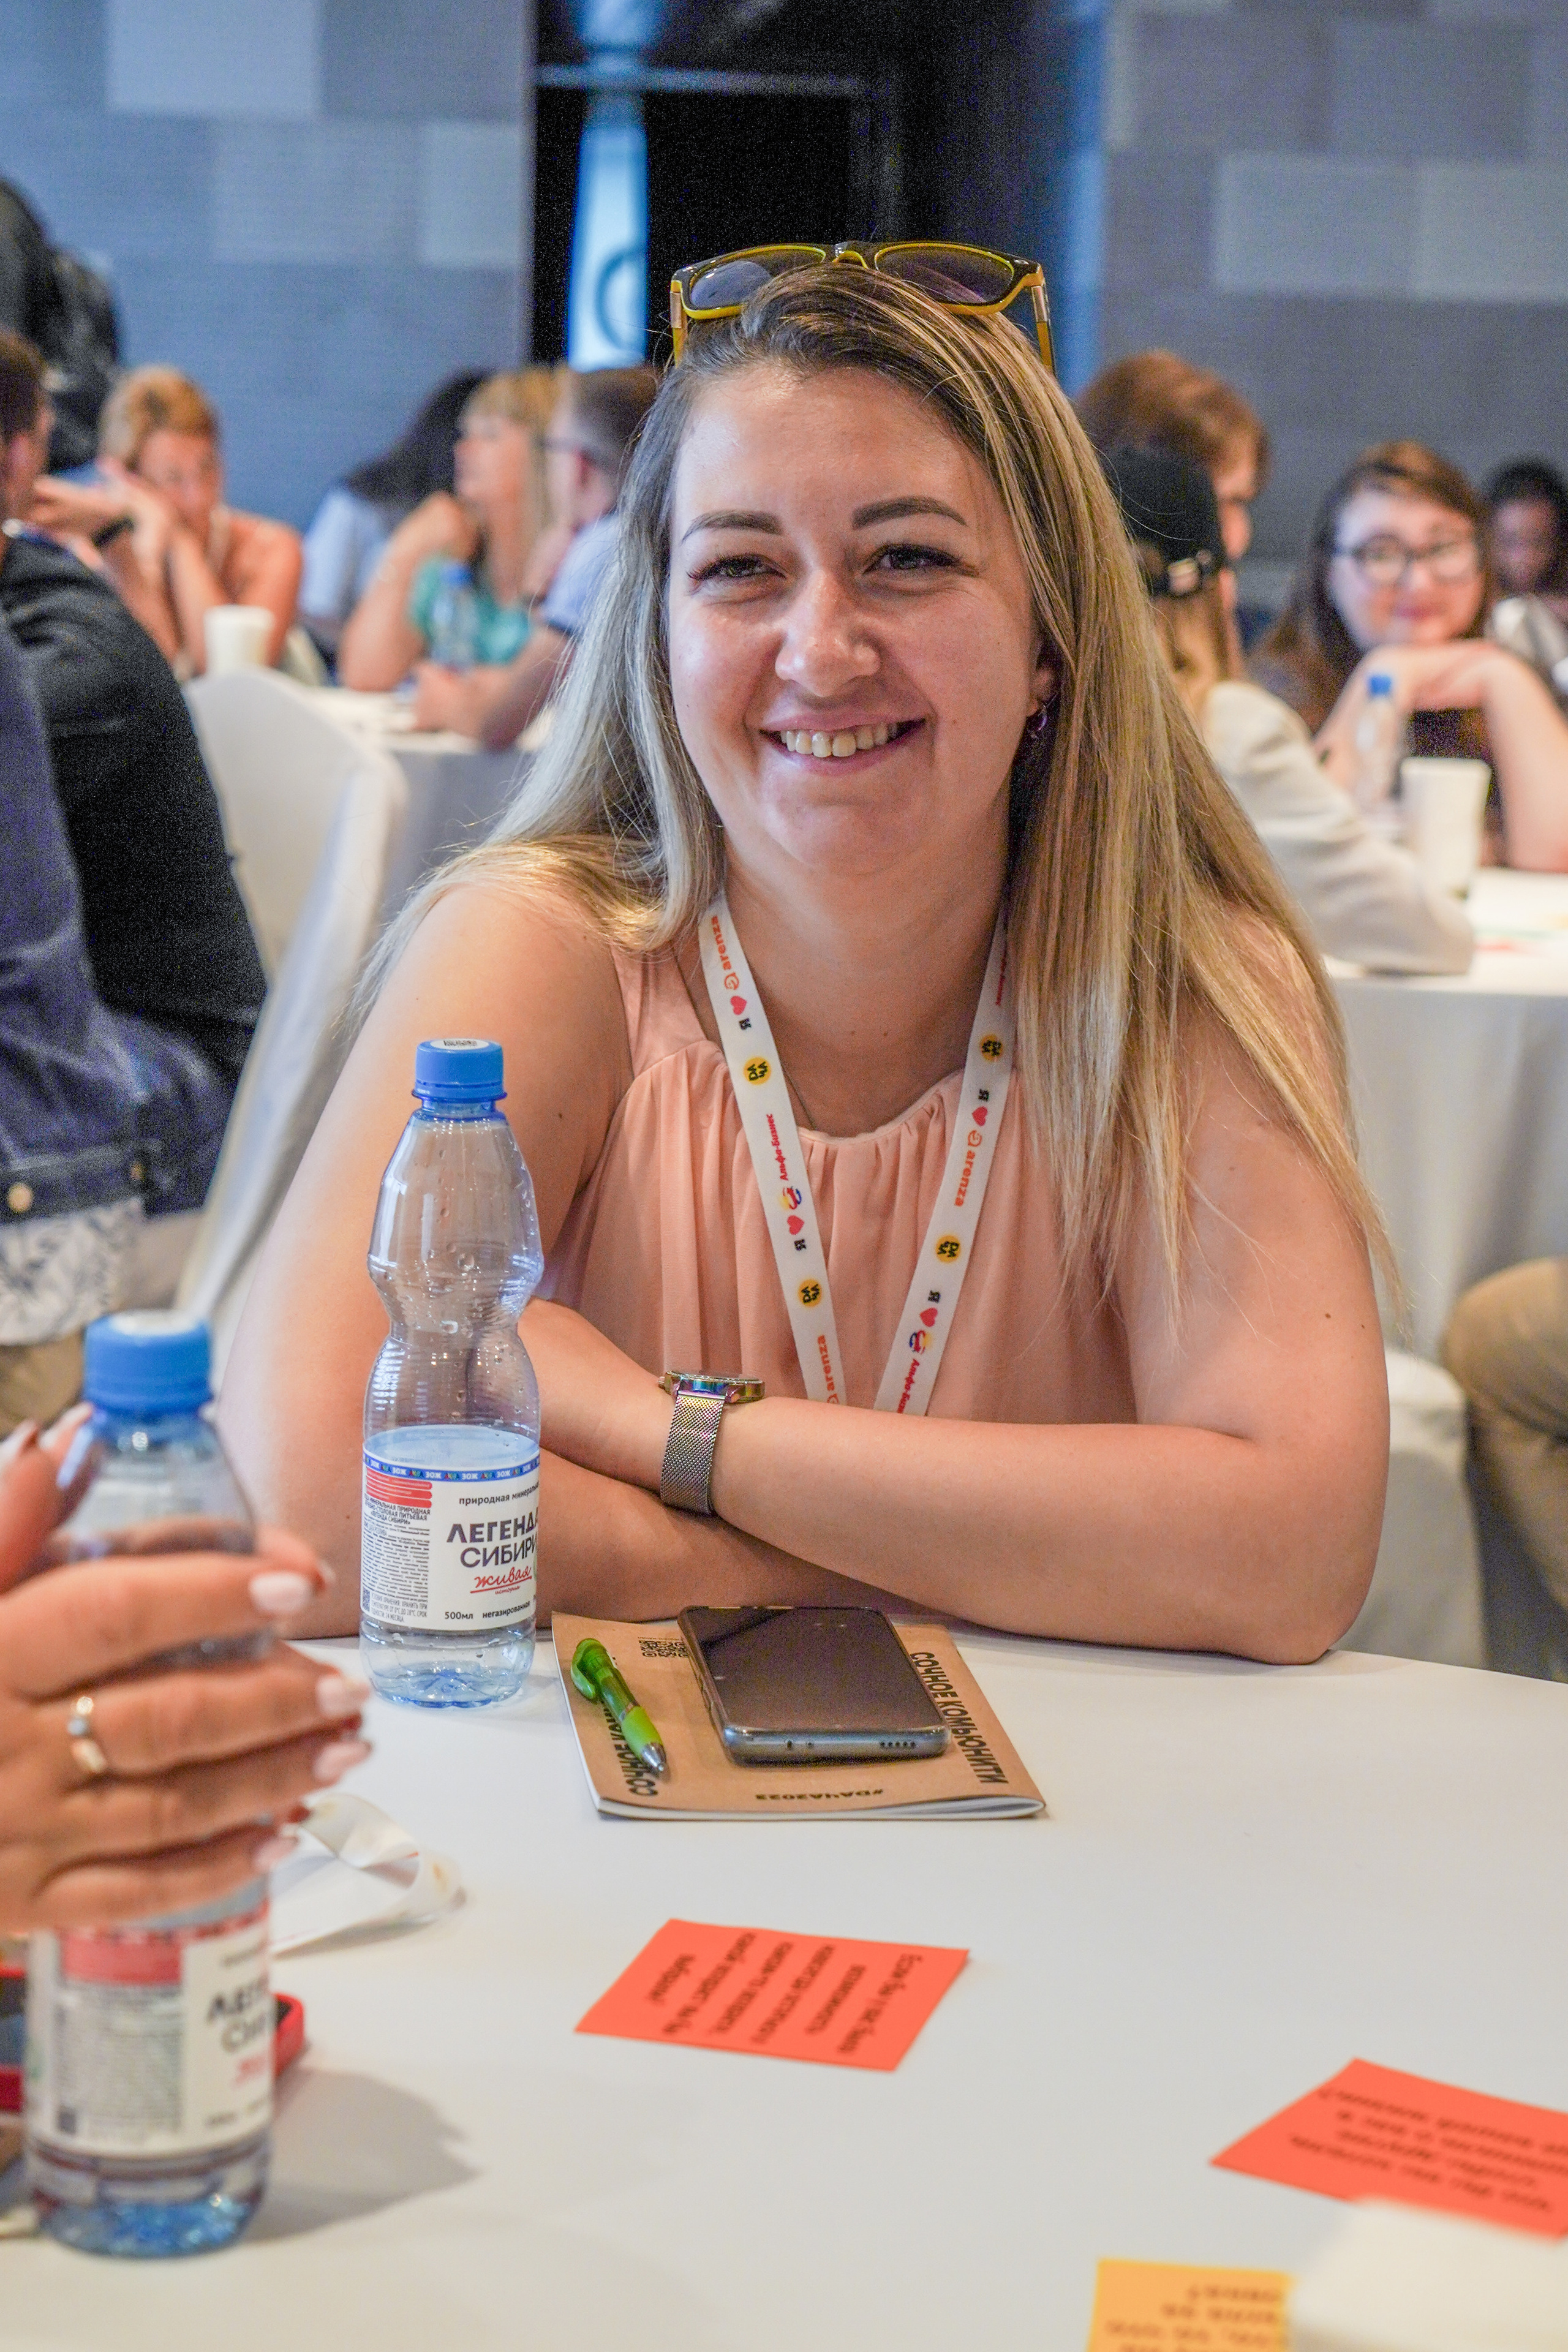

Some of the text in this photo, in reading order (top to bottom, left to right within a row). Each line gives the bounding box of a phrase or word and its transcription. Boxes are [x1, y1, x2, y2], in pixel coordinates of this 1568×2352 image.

[711, 915, 732, 970] arenza
[954, 1150, 976, 1207] arenza
[818, 1335, 835, 1391] arenza
[397, 1506, 430, 1515] ПРИРОДНАЯ
[399, 1512, 428, 1521] ПИТЬЕВАЯ
[459, 1494, 510, 1506] природная
[474, 1567, 532, 1588] живая
[910, 1652, 1008, 1783] СОЧНОЕ КОМЬЮНИТИ
